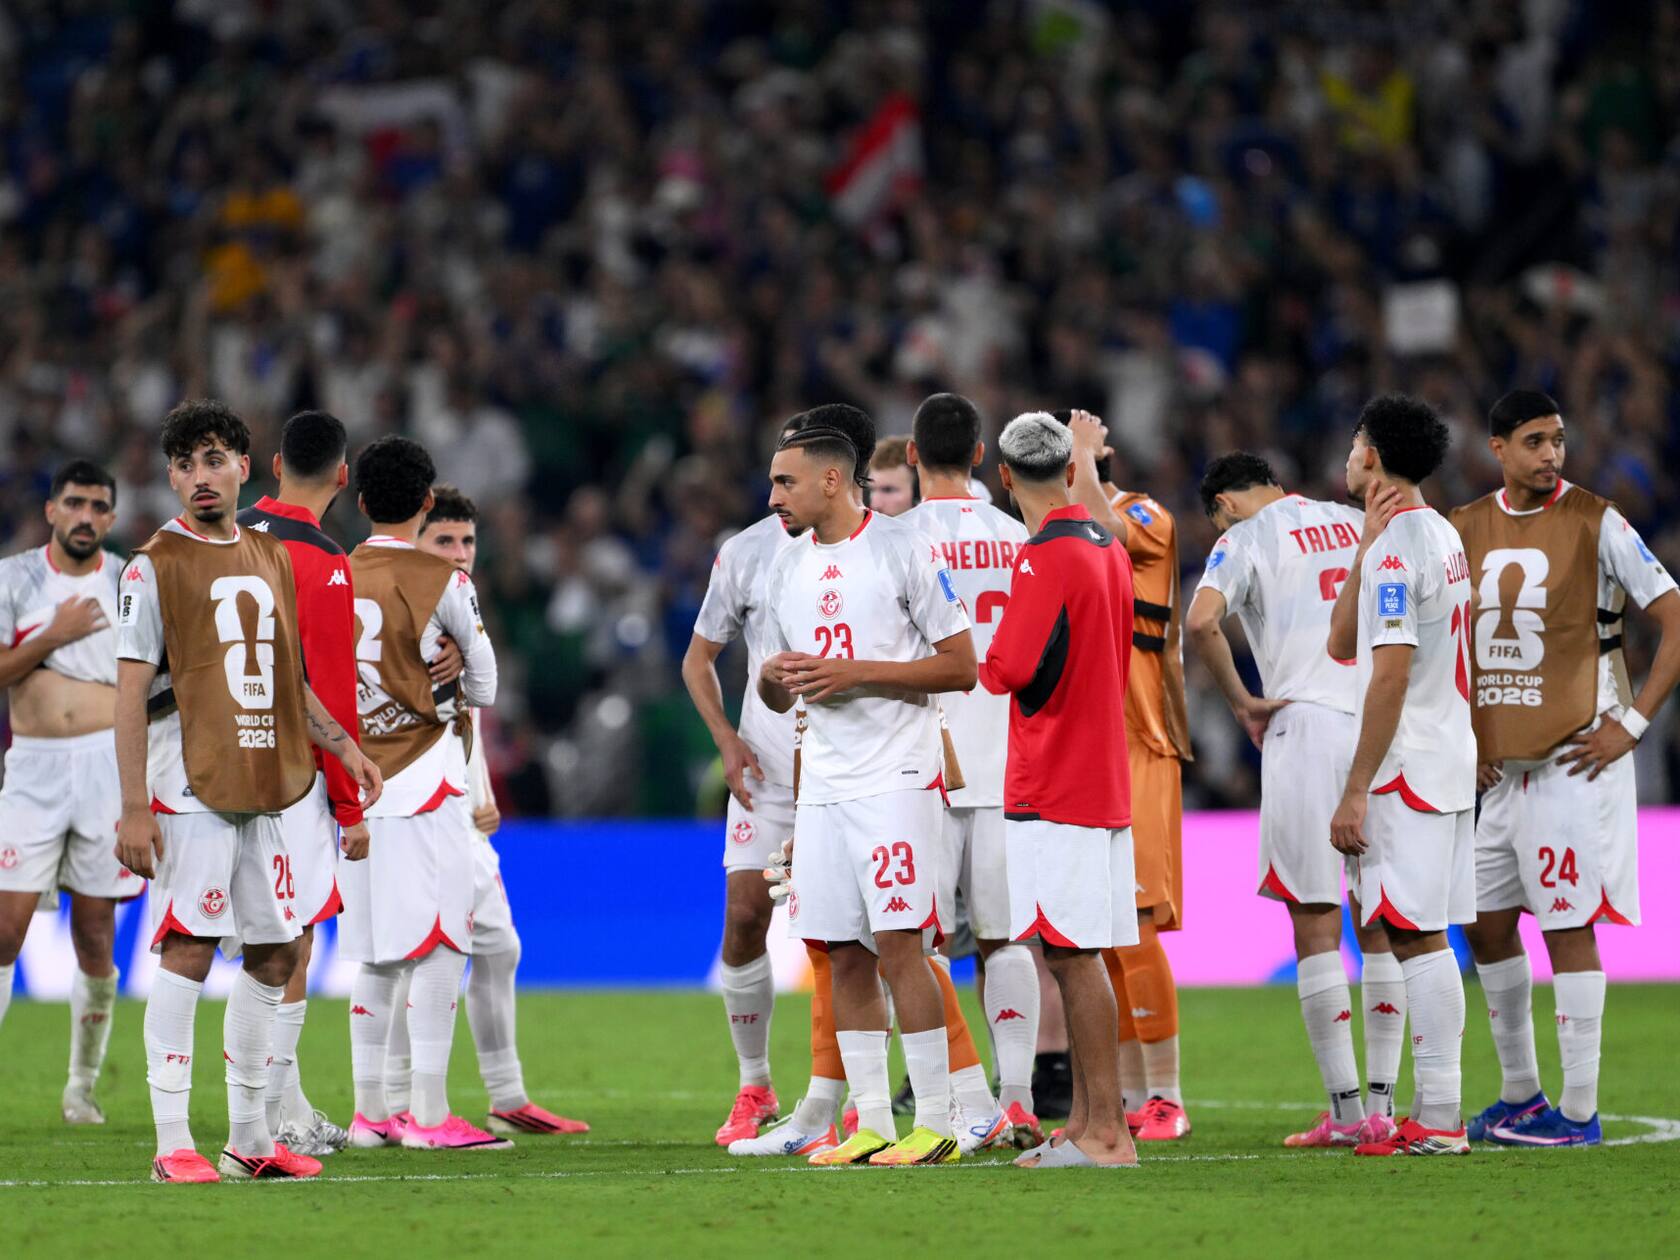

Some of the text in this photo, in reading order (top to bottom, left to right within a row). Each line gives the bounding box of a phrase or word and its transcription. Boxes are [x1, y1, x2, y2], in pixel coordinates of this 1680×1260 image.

[1289, 522, 1361, 554] TALBI
[940, 541, 1024, 570] HEDIR
[814, 622, 855, 660] 23
[1489, 645, 1523, 659] FIFA
[243, 683, 267, 697] FIFA
[1515, 674, 1544, 688] CUP
[1477, 687, 1543, 708] 2026
[237, 728, 276, 748] 2026
[272, 853, 296, 900] 26
[872, 841, 917, 889] 23
[1538, 846, 1580, 888] 24
[731, 1013, 759, 1025] FTF
